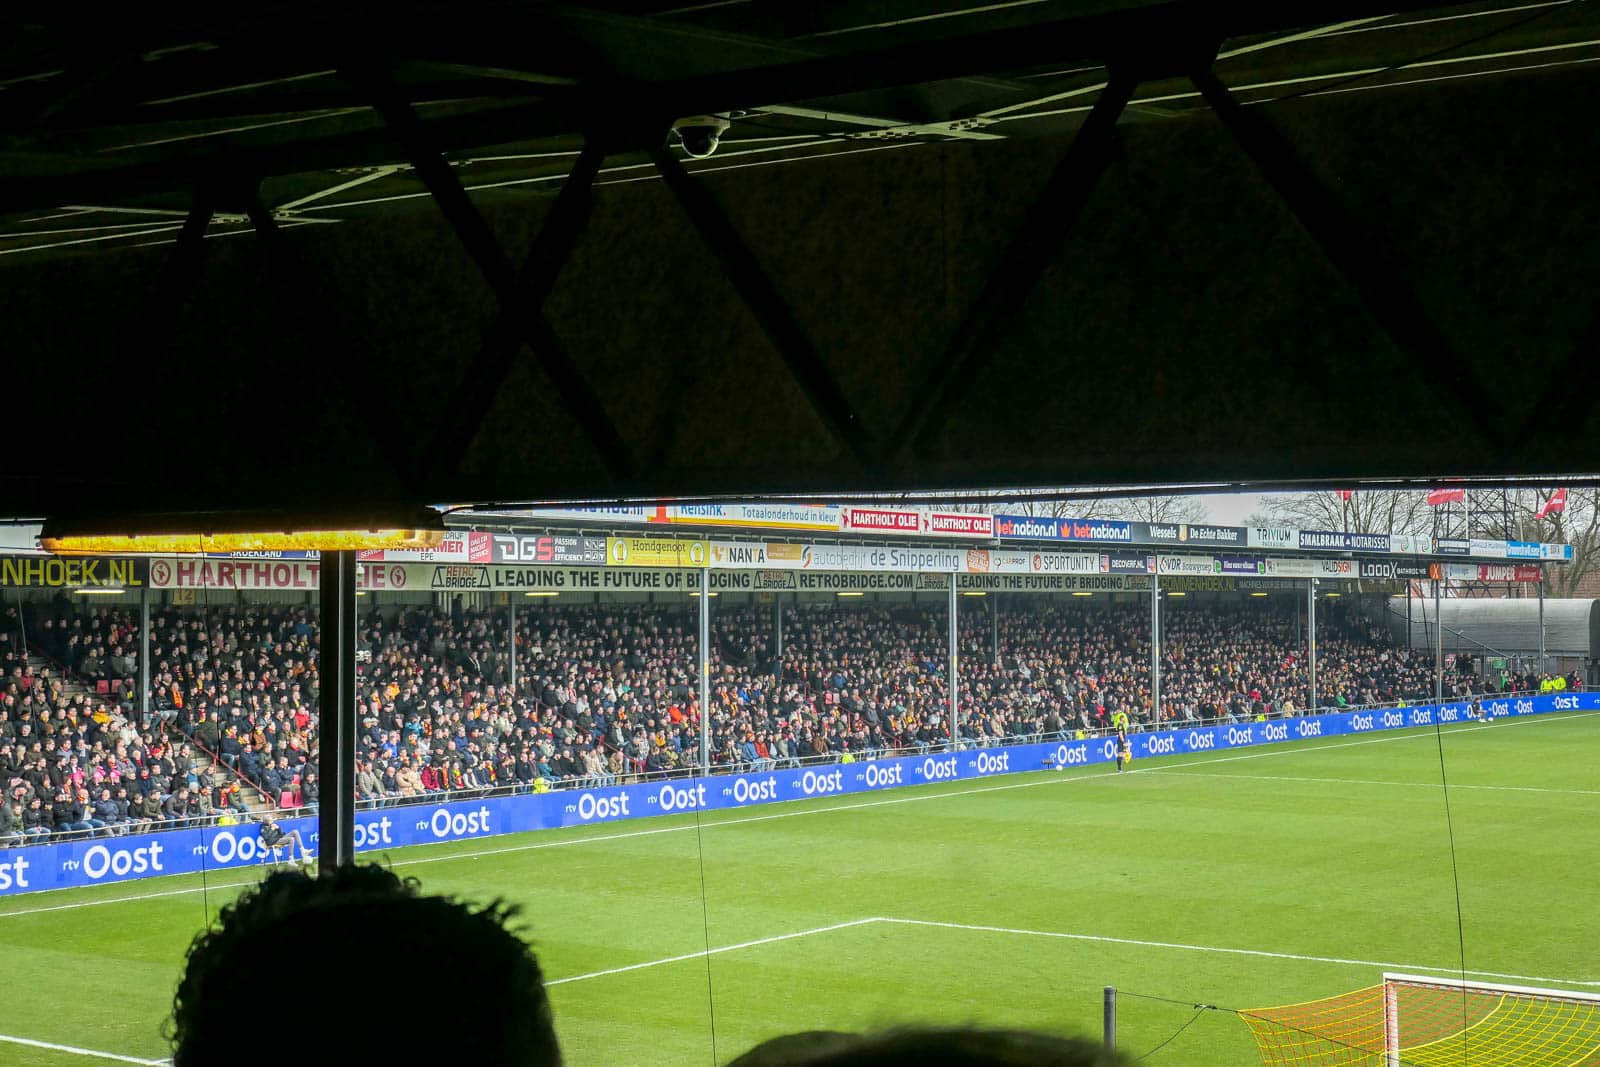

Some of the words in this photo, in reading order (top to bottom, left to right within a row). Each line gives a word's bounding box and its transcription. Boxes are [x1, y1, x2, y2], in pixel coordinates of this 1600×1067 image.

[742, 507, 808, 521] Totaalonderhoud
[811, 511, 818, 521] in
[819, 511, 837, 522] kleur
[853, 511, 896, 526] HARTHOLT
[898, 514, 917, 527] OLIE
[933, 516, 971, 530] HARTHOLT
[973, 519, 991, 531] OLIE
[994, 519, 1057, 537] betnation.nl
[1073, 522, 1130, 539] betnation.nl
[1150, 525, 1177, 538] Wessels
[554, 538, 577, 546] PASSION
[1190, 528, 1199, 539] De
[1200, 528, 1216, 540] Echte
[1217, 529, 1238, 541] Bakker
[1257, 528, 1291, 541] TRIVIUM
[1300, 533, 1345, 547] SMALBRAAK
[1351, 536, 1390, 549] NOTARISSEN
[632, 540, 686, 553] Hondgenoot
[420, 552, 434, 561] EPE
[554, 553, 584, 561] EFFICIENCY
[813, 550, 867, 569] autobedrijf
[870, 550, 886, 566] de
[890, 550, 960, 571] Snipperling
[1043, 555, 1095, 571] SPORTUNITY
[2, 558, 142, 586] NHOEK.NL
[176, 561, 320, 588] HARTHOLT
[357, 565, 386, 588] IE
[495, 570, 565, 587] LEADING
[569, 571, 599, 587] THE
[604, 571, 661, 588] FUTURE
[665, 572, 682, 588] OF
[687, 572, 750, 588] BDGING
[1485, 566, 1515, 581] JUMPER
[446, 576, 477, 588] BRIDGE
[800, 574, 913, 588] RETROBRIDGE.COM
[956, 574, 1000, 588] LEADING
[1002, 575, 1023, 588] THE
[1025, 575, 1063, 589] FUTURE
[1065, 576, 1077, 589] OF
[1079, 576, 1123, 590] BRIDGING
[1383, 711, 1403, 727] Oost
[1413, 709, 1432, 724] Oost
[1441, 706, 1458, 721] Oost
[1265, 722, 1288, 740] Oost
[1300, 719, 1322, 737] Oost
[1352, 714, 1374, 731] Oost
[1148, 734, 1175, 754] Oost
[1189, 731, 1215, 750] Oost
[1228, 726, 1253, 745] Oost
[1057, 743, 1087, 764] Oost
[1104, 739, 1133, 760] Ot
[923, 757, 957, 780] Oost
[977, 751, 1009, 773] Oost
[792, 778, 801, 789] rtv
[802, 769, 843, 794] Oost
[865, 762, 903, 787] Oost
[647, 794, 658, 805] rtv
[659, 783, 707, 811] Oost
[722, 786, 733, 797] rtv
[733, 776, 777, 802] Oost
[565, 803, 577, 814] rtv
[578, 791, 630, 820] Oost
[415, 819, 430, 831] rtv
[431, 806, 491, 838] Oost
[309, 830, 320, 843] rt
[354, 815, 393, 848] ost
[192, 842, 209, 856] rtv
[62, 856, 80, 871] rtv
[83, 840, 164, 879] Oost
